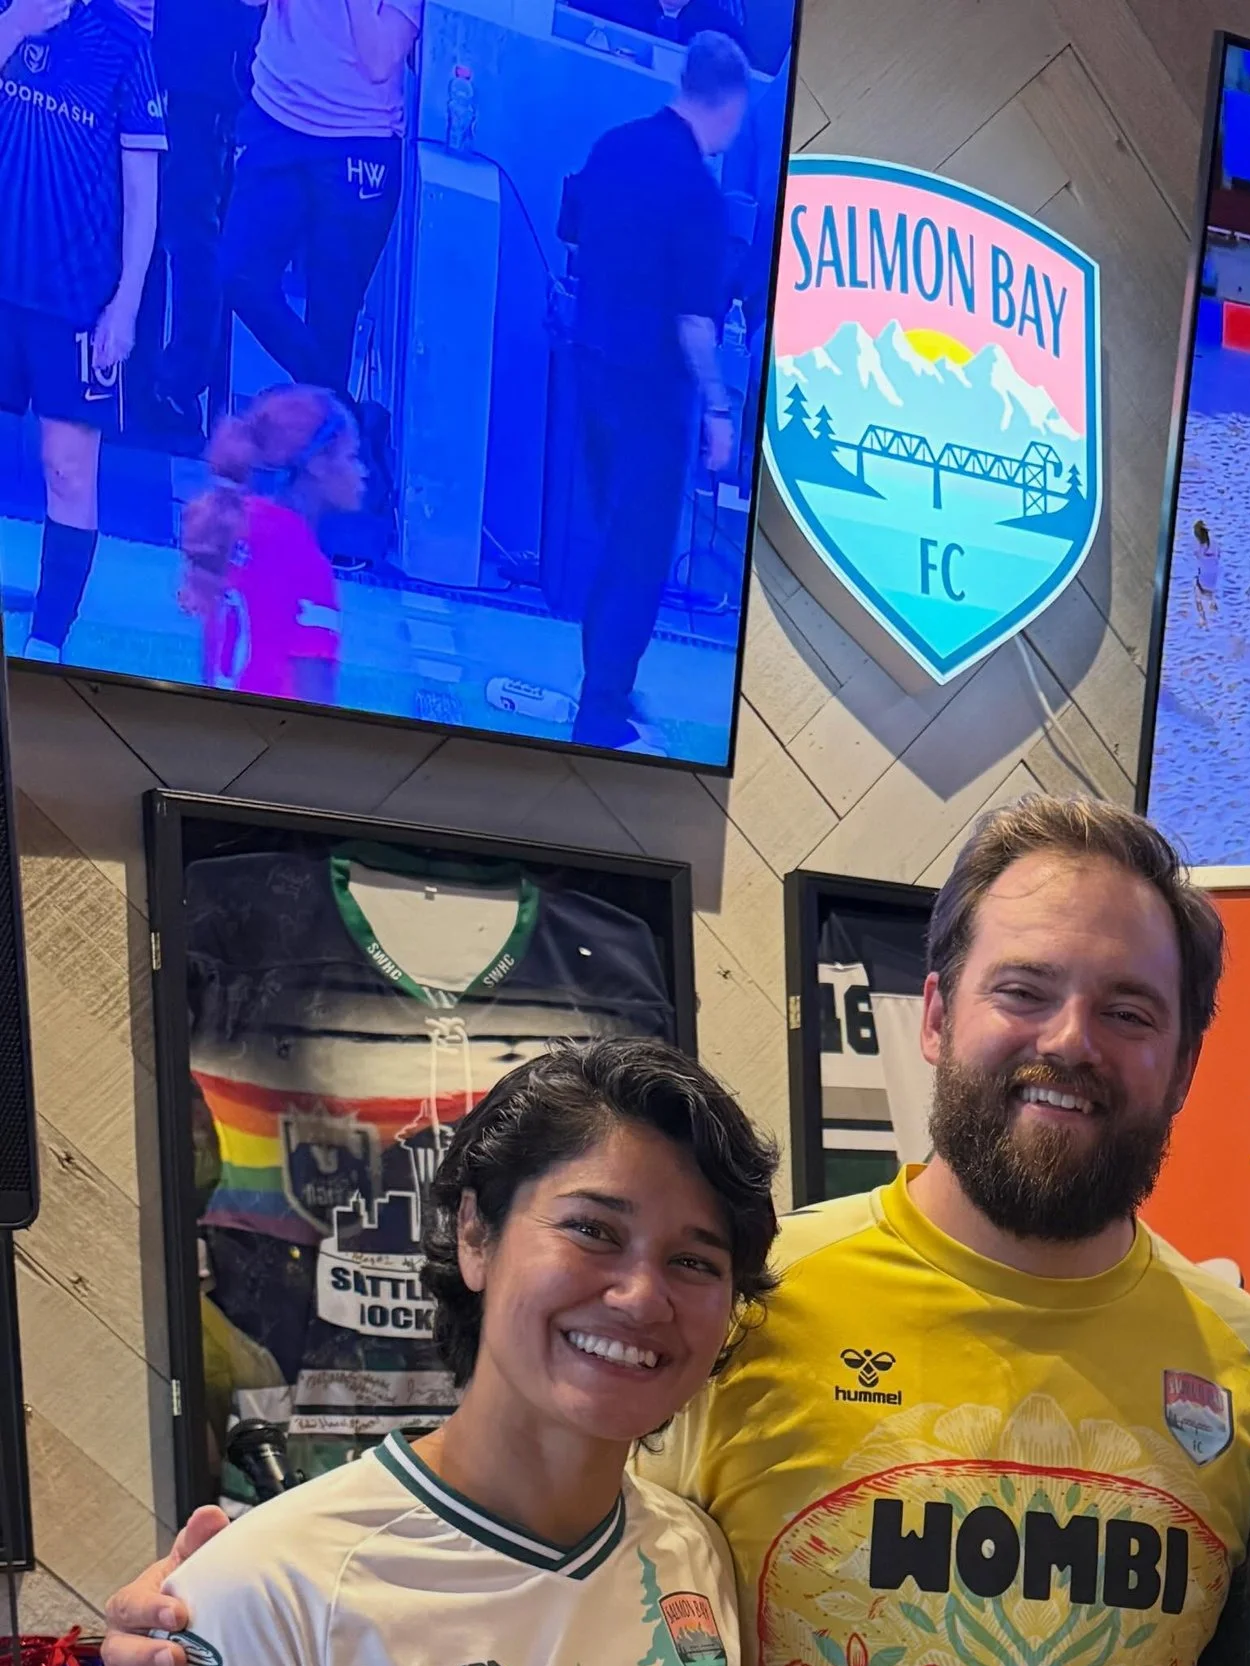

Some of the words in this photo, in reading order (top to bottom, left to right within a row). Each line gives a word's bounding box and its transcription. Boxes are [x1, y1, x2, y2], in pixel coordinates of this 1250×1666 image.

[347, 156, 386, 189] HW
[790, 203, 976, 315] SALMON
[990, 243, 1068, 360] BAY
[919, 536, 966, 603] FC
[366, 941, 403, 982] SWHC
[483, 952, 516, 990] SWHC
[834, 1386, 902, 1406] hummel
[868, 1498, 1189, 1615] WOMBI
